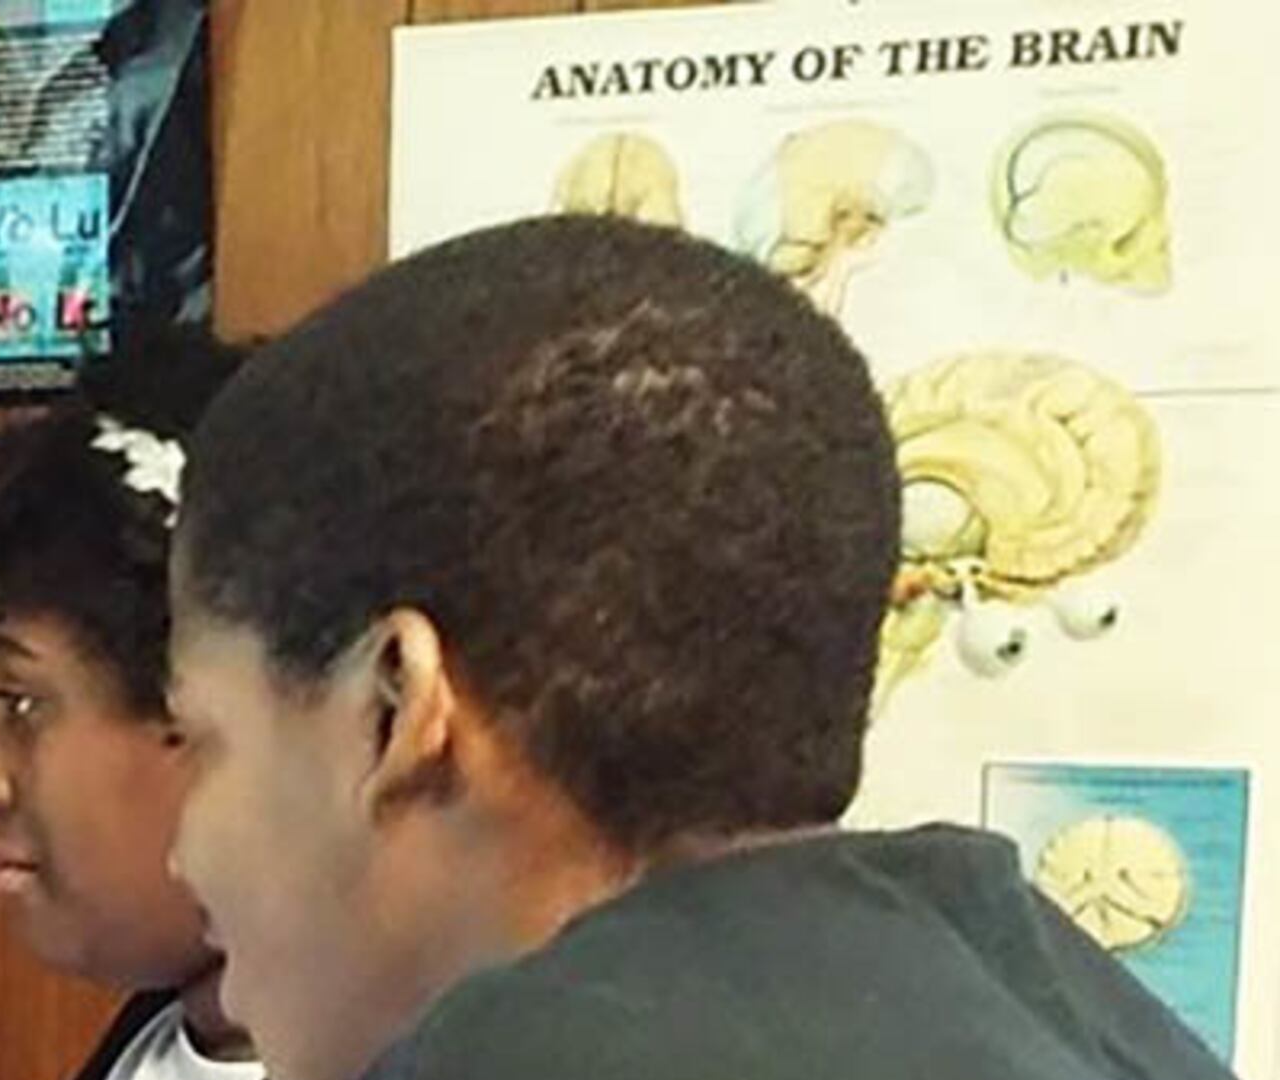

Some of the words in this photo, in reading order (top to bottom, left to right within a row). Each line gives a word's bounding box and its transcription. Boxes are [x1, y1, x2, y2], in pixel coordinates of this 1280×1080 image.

[530, 49, 777, 101] ANATOMY
[791, 42, 865, 84] OF
[877, 32, 990, 78] THE
[1008, 18, 1186, 69] BRAIN
[50, 200, 101, 242] Lu
